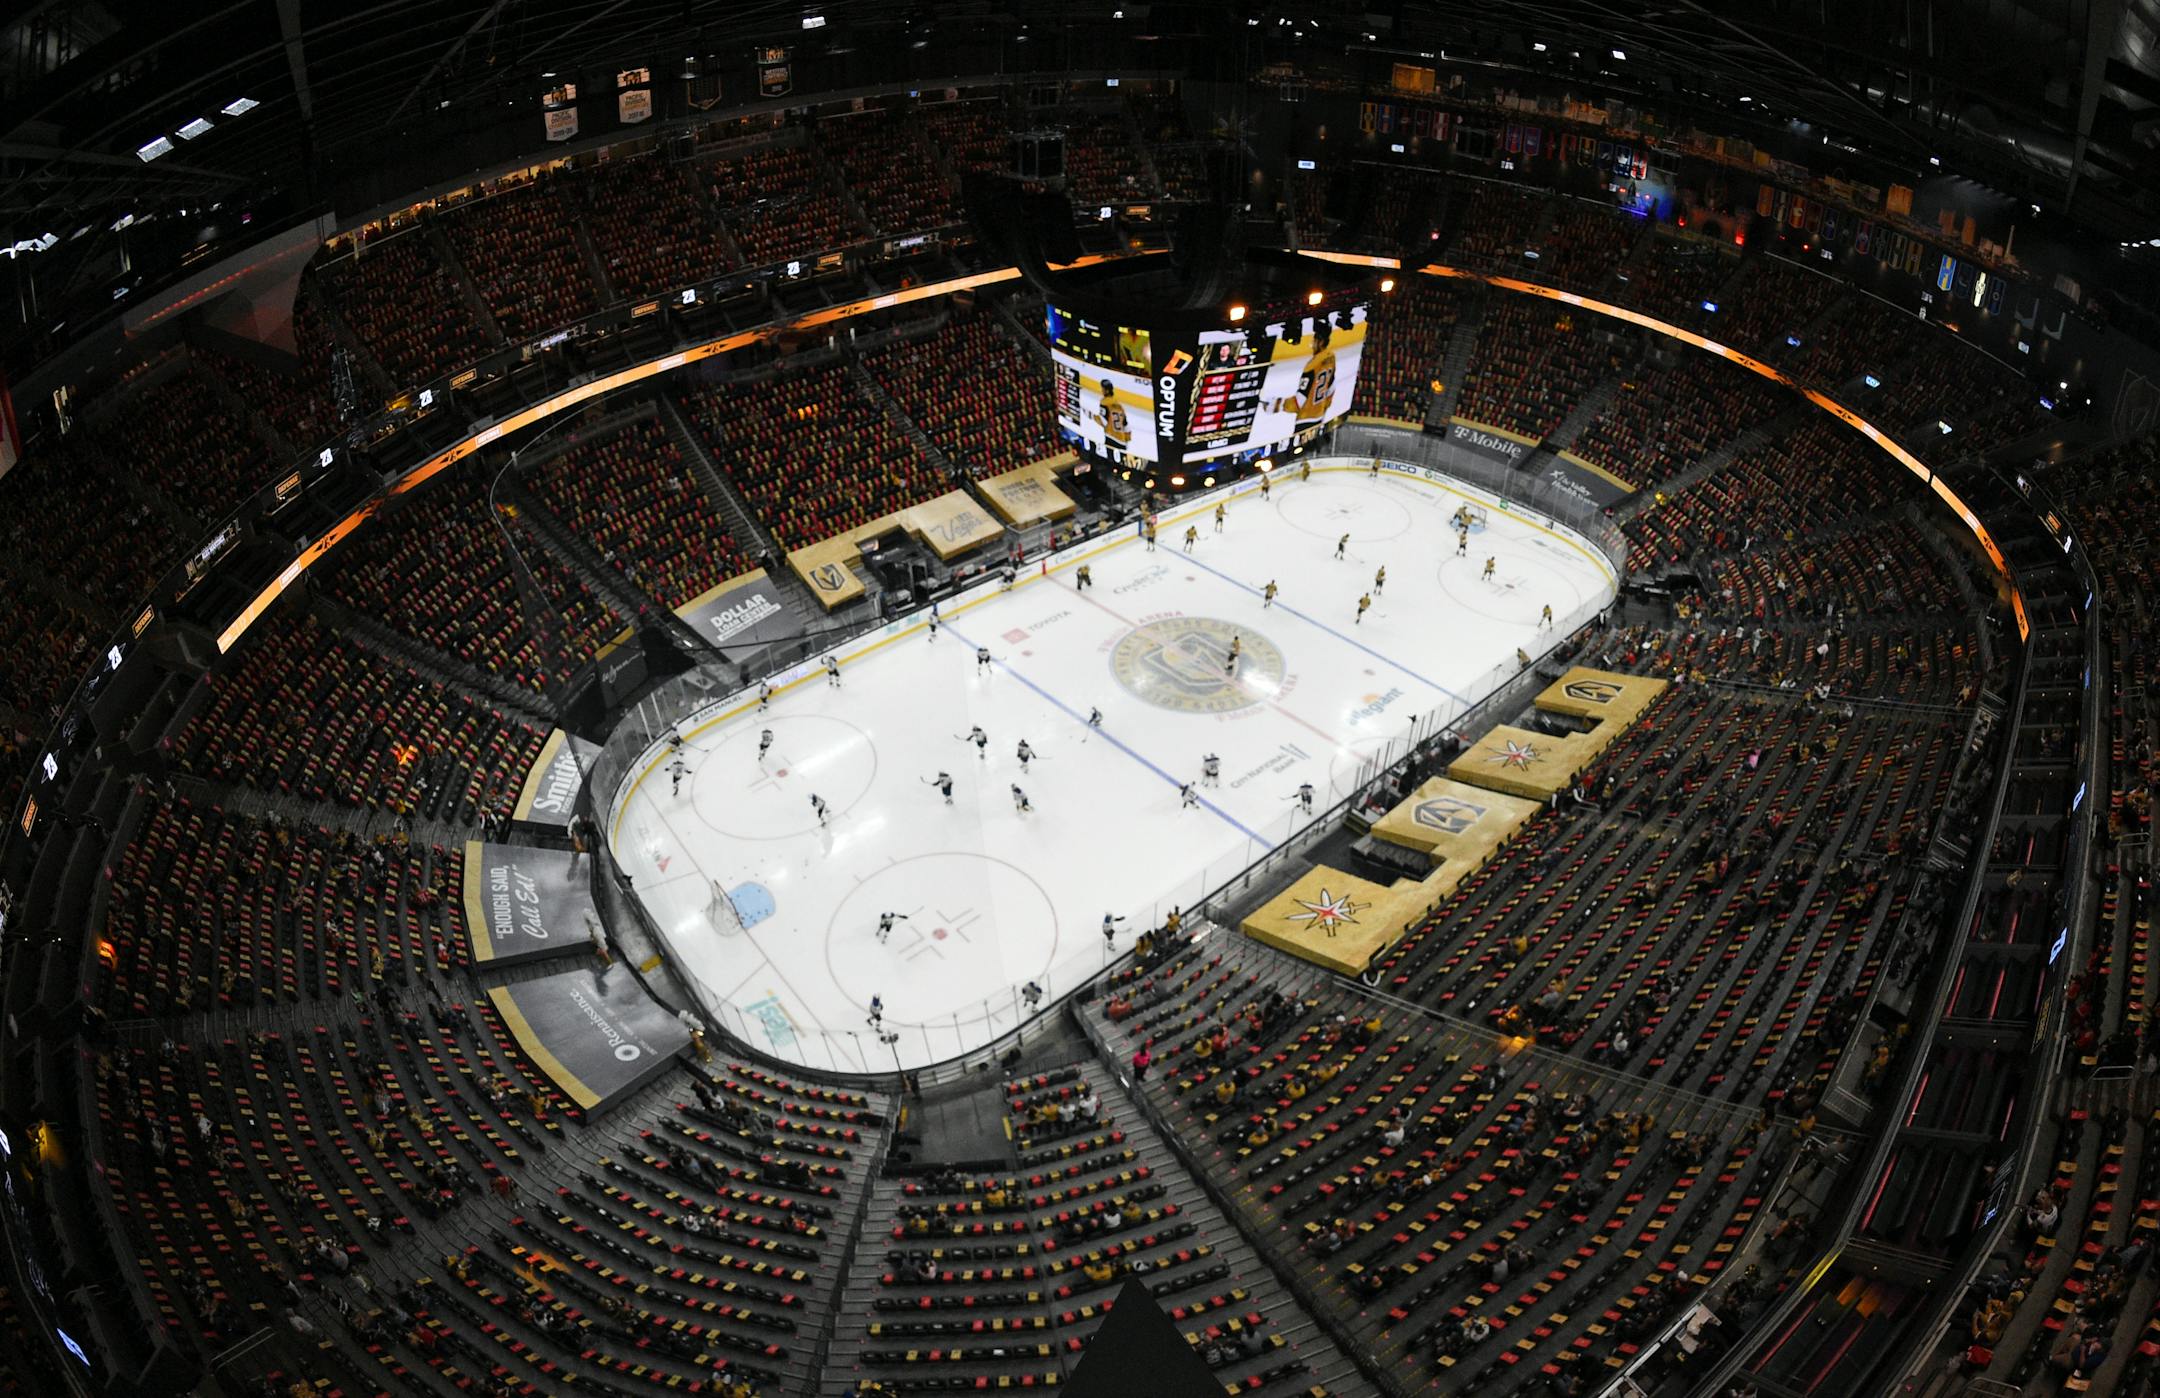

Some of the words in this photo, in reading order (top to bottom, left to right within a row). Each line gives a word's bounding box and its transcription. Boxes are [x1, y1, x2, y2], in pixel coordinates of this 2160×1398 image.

[1158, 375, 1176, 437] OPTUM
[1468, 431, 1521, 459] Mobile
[710, 593, 767, 628] DOLLAR
[718, 618, 741, 633] LOAN
[740, 601, 772, 621] CENTER
[1027, 610, 1072, 632] TOYOTA
[533, 751, 578, 813] Smith's
[490, 865, 510, 892] SAID,
[520, 904, 549, 939] Call
